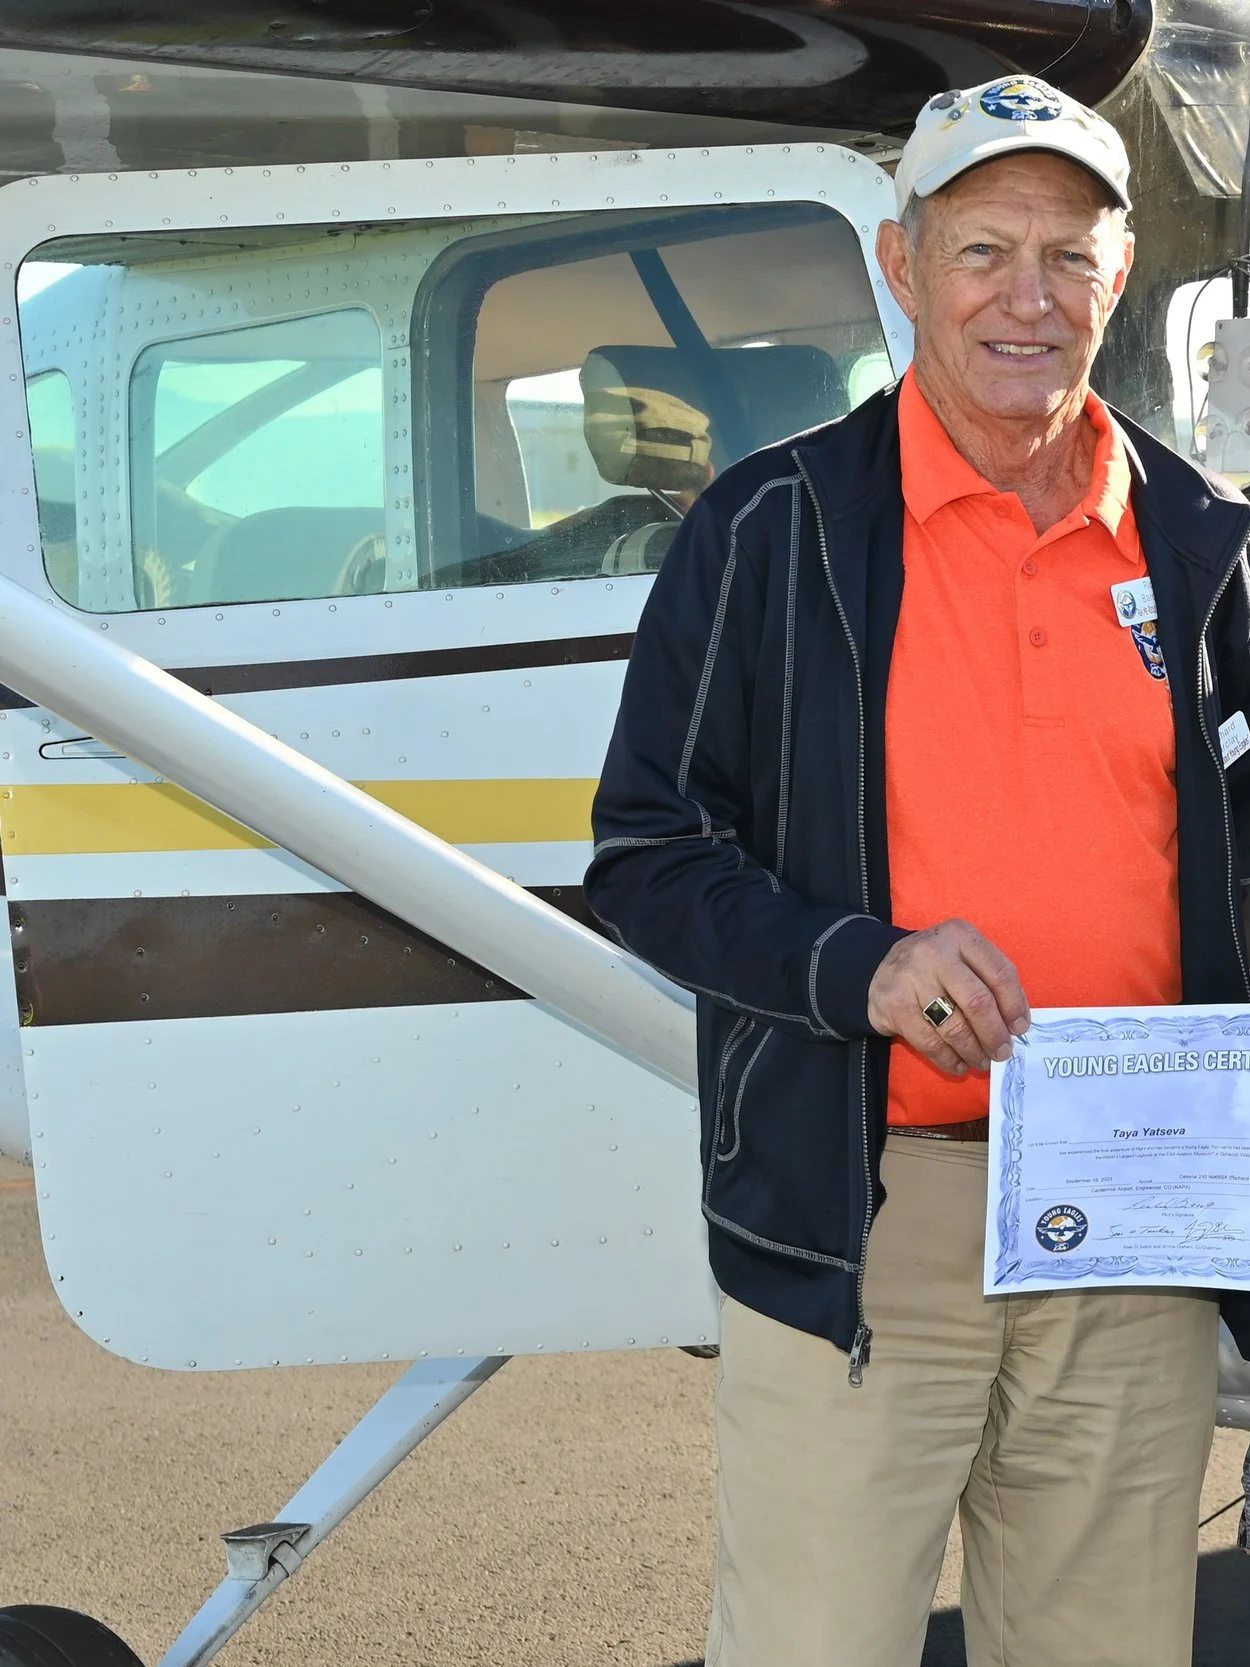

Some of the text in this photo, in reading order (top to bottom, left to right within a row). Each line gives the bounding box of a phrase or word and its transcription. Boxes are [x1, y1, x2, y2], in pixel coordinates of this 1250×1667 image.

[1044, 1053, 1117, 1078] YOUNG
[1122, 1051, 1199, 1074] EAGLES
[1112, 1127, 1186, 1139] Taya Yatseva
[1041, 1207, 1084, 1224] YOUNG EAGLES
